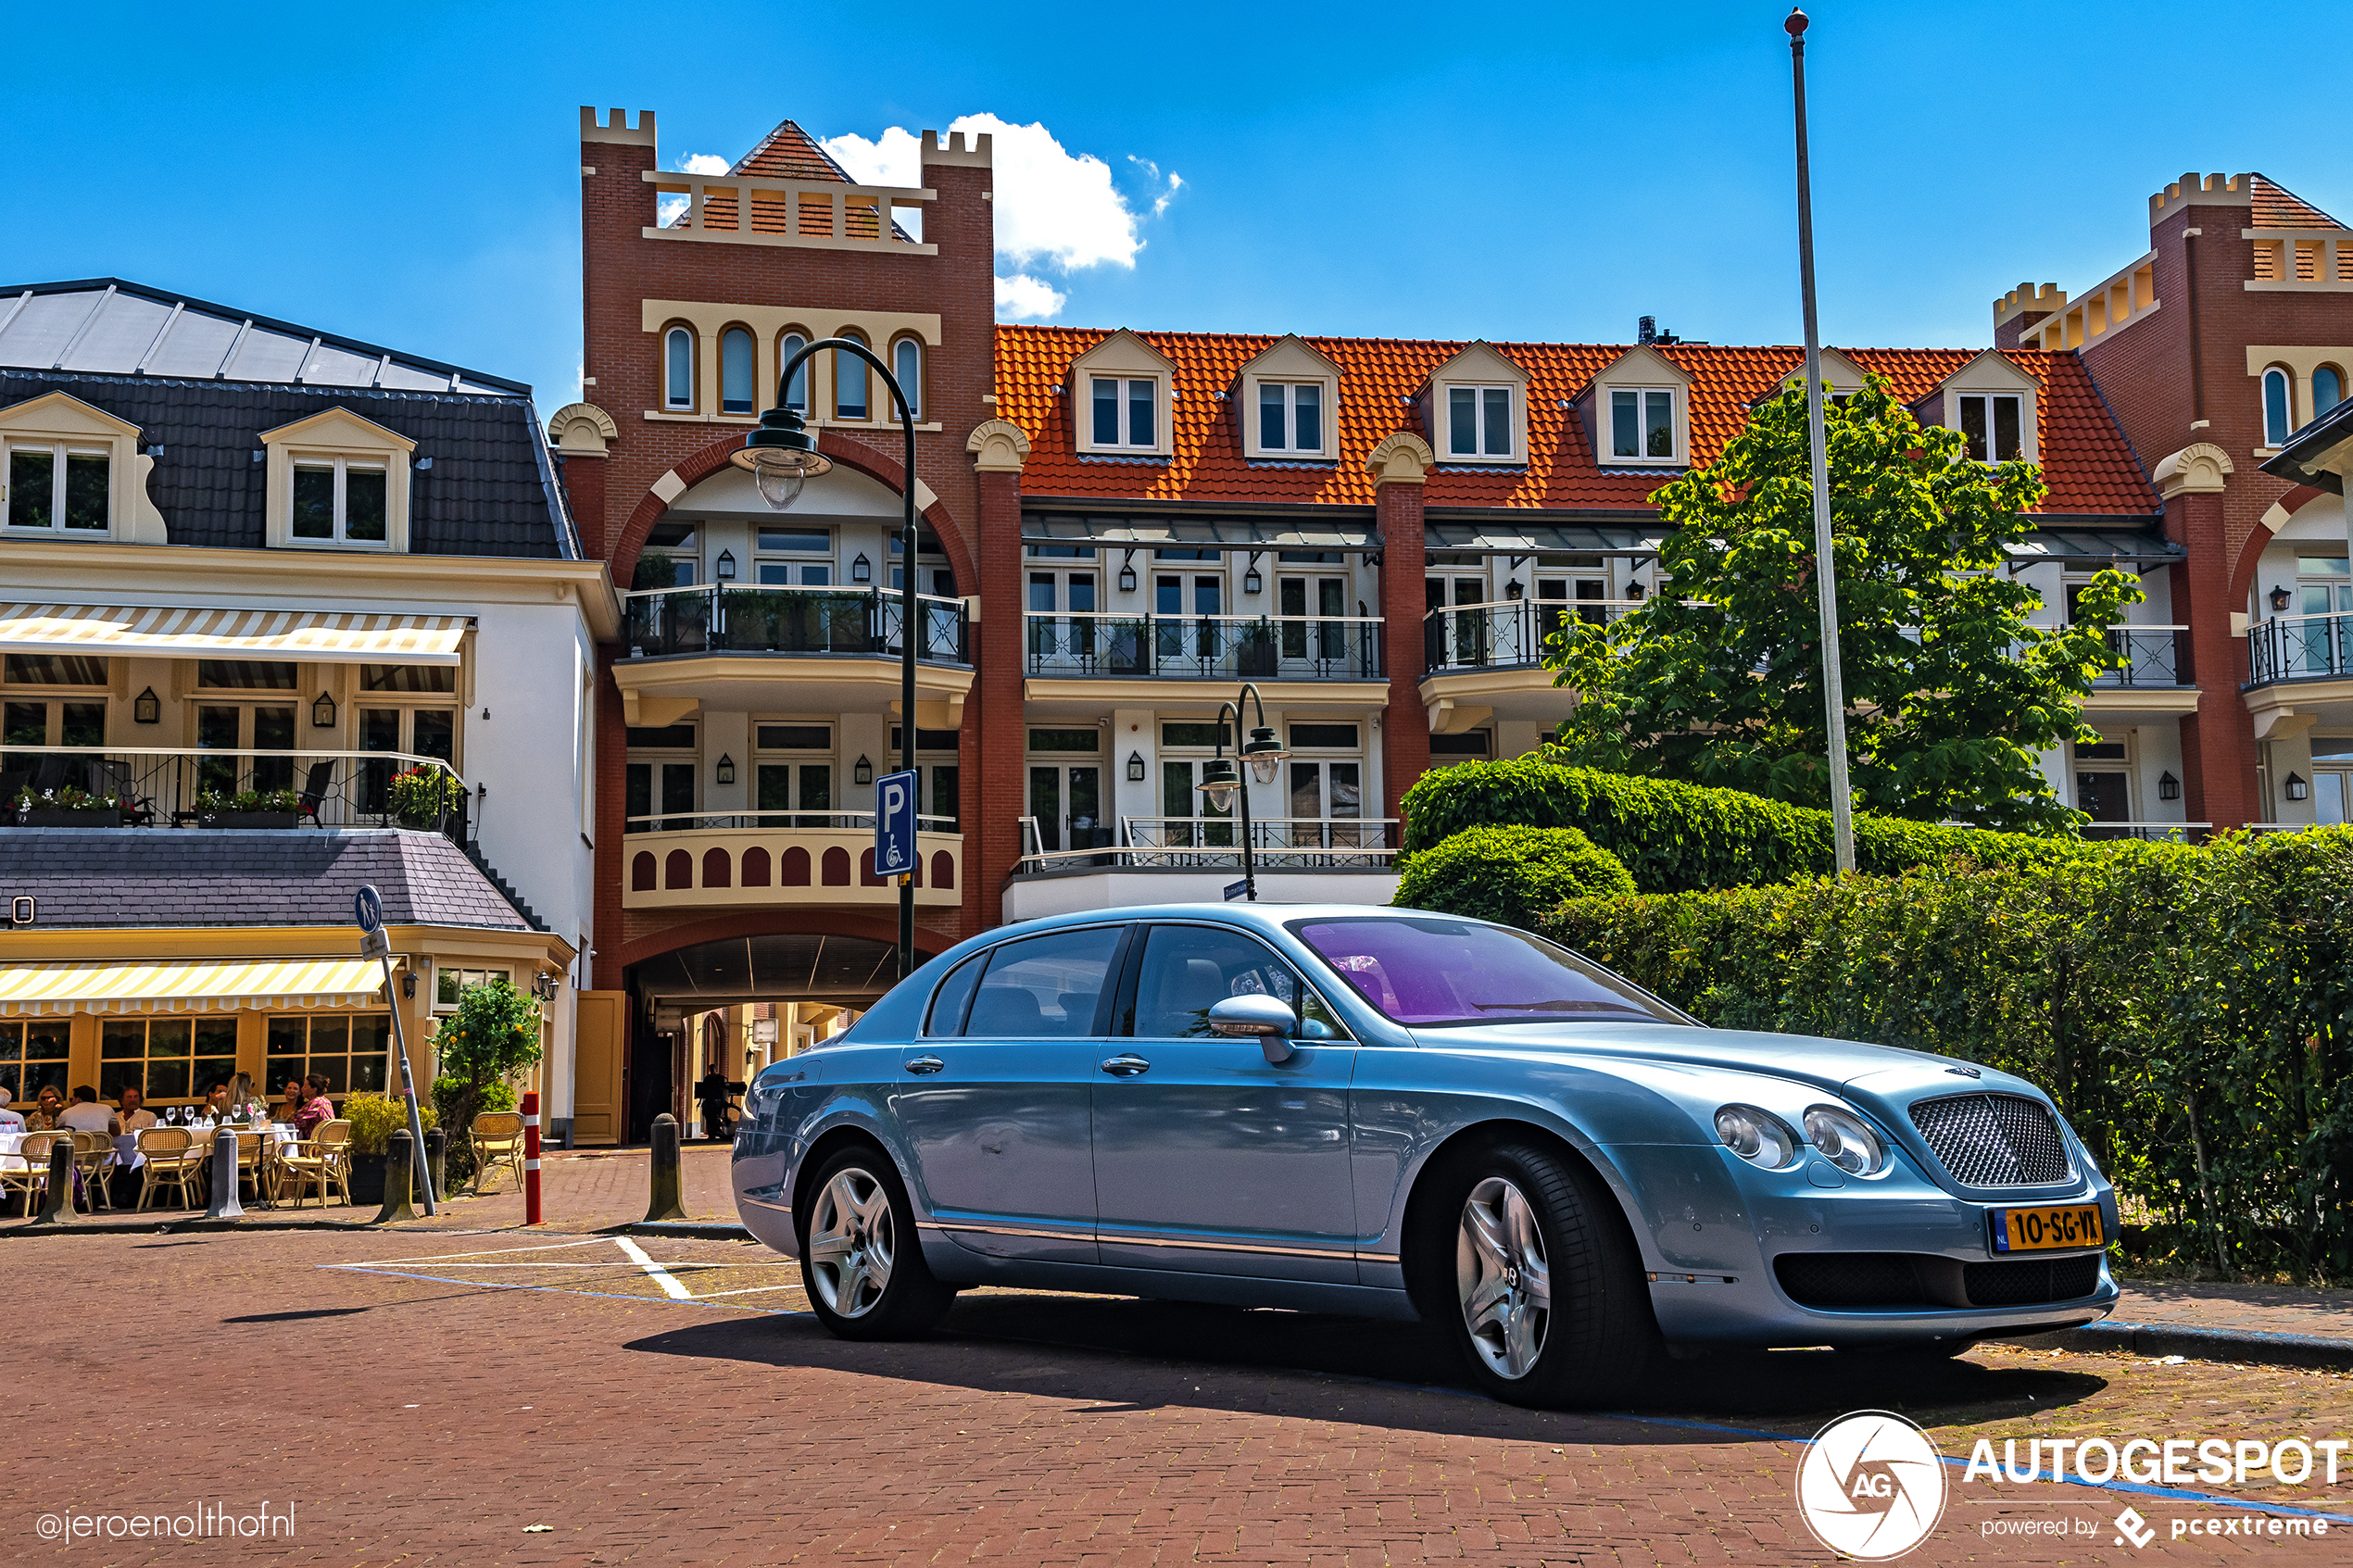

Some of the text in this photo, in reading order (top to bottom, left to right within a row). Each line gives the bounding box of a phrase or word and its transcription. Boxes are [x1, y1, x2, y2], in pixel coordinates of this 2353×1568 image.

[884, 784, 905, 833] P
[1996, 1235, 2007, 1245] NL
[2015, 1210, 2098, 1244] 10-SG-VX
